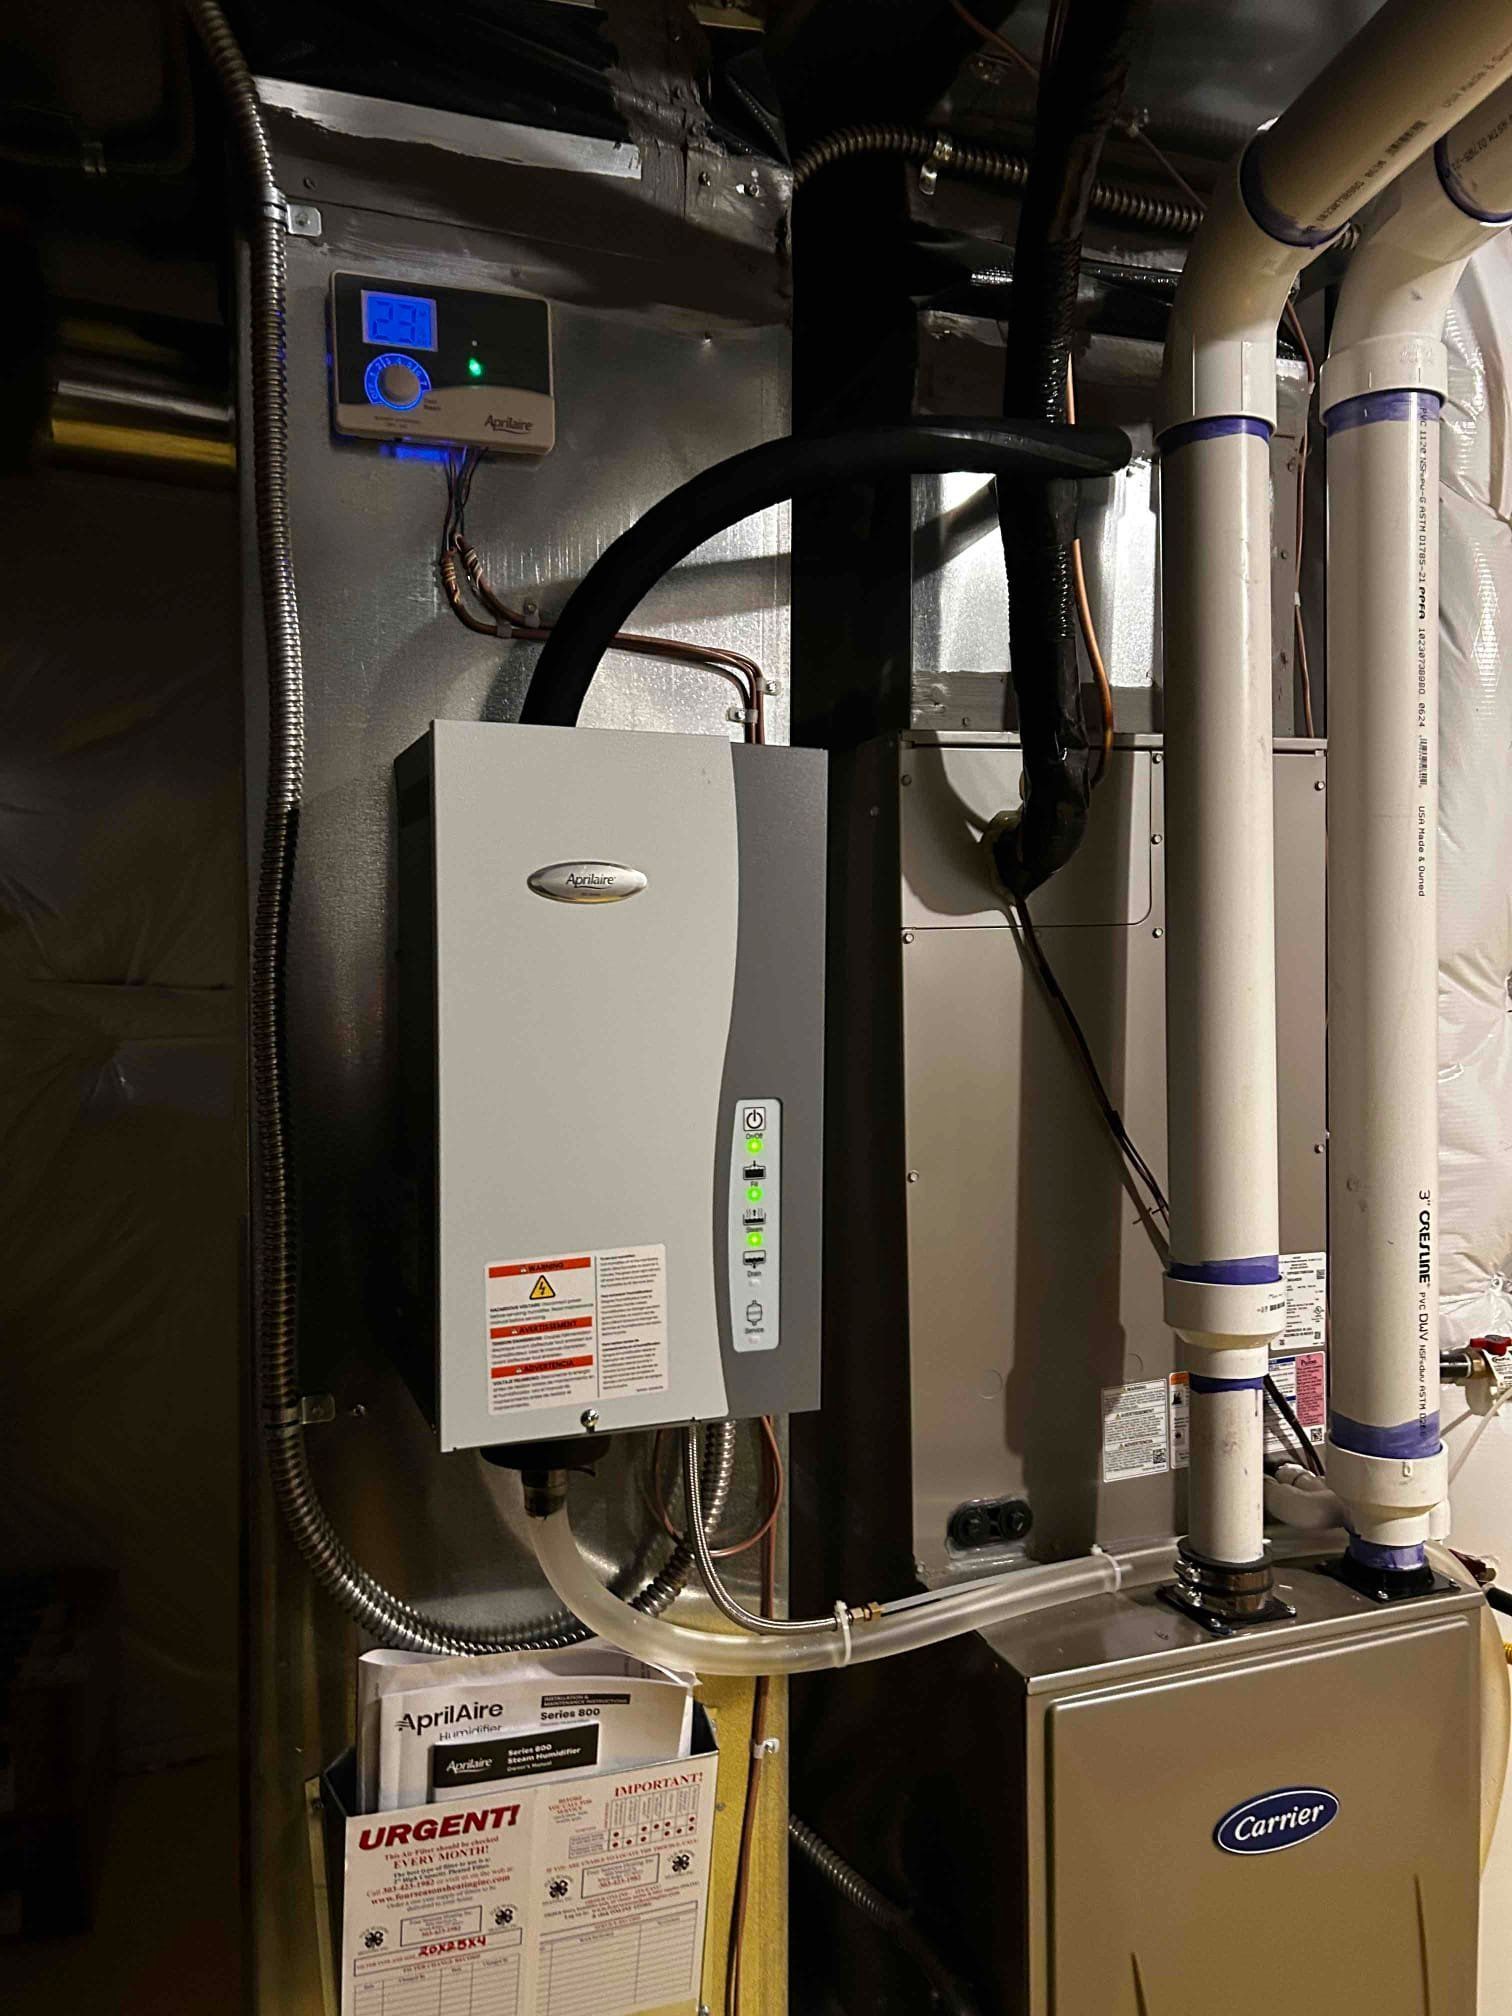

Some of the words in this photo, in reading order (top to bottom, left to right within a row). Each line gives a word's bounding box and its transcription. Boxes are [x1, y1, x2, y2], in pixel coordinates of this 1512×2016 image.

[373, 300, 416, 343] 23
[484, 414, 533, 433] Aprilaire
[1418, 407, 1427, 427] PVC
[1418, 430, 1427, 455] 1120
[1418, 506, 1427, 533] ASTM
[1418, 535, 1426, 583] D1785-21
[1418, 702, 1426, 728] 0624
[566, 873, 615, 889] Aprilaire
[1418, 1189, 1431, 1206] 3"
[528, 1262, 564, 1272] WARNING
[1418, 1291, 1426, 1311] PVC
[519, 1320, 577, 1334] AVERTISSEMENT
[744, 1325, 764, 1335] Service
[1418, 1313, 1429, 1341] DWV
[523, 1359, 574, 1373] ADVERTENCIA
[1418, 1384, 1426, 1410] ASTM
[398, 1701, 504, 1735] AprilAire
[540, 1709, 576, 1721] Series
[578, 1706, 601, 1718] 800
[507, 1753, 535, 1764] Steam
[535, 1747, 581, 1760] Humidifier
[508, 1747, 534, 1757] Series
[445, 1756, 494, 1774] Aprilaire
[614, 1771, 704, 1798] IMPORTANT!
[358, 1804, 521, 1851] URGENT!
[1235, 1804, 1324, 1841] Carrier
[384, 1852, 400, 1861] This
[415, 1847, 434, 1856] Filter
[436, 1841, 460, 1852] should
[471, 1835, 499, 1846] checked
[393, 1854, 434, 1869] EVERY
[439, 1844, 489, 1861] MONTH!
